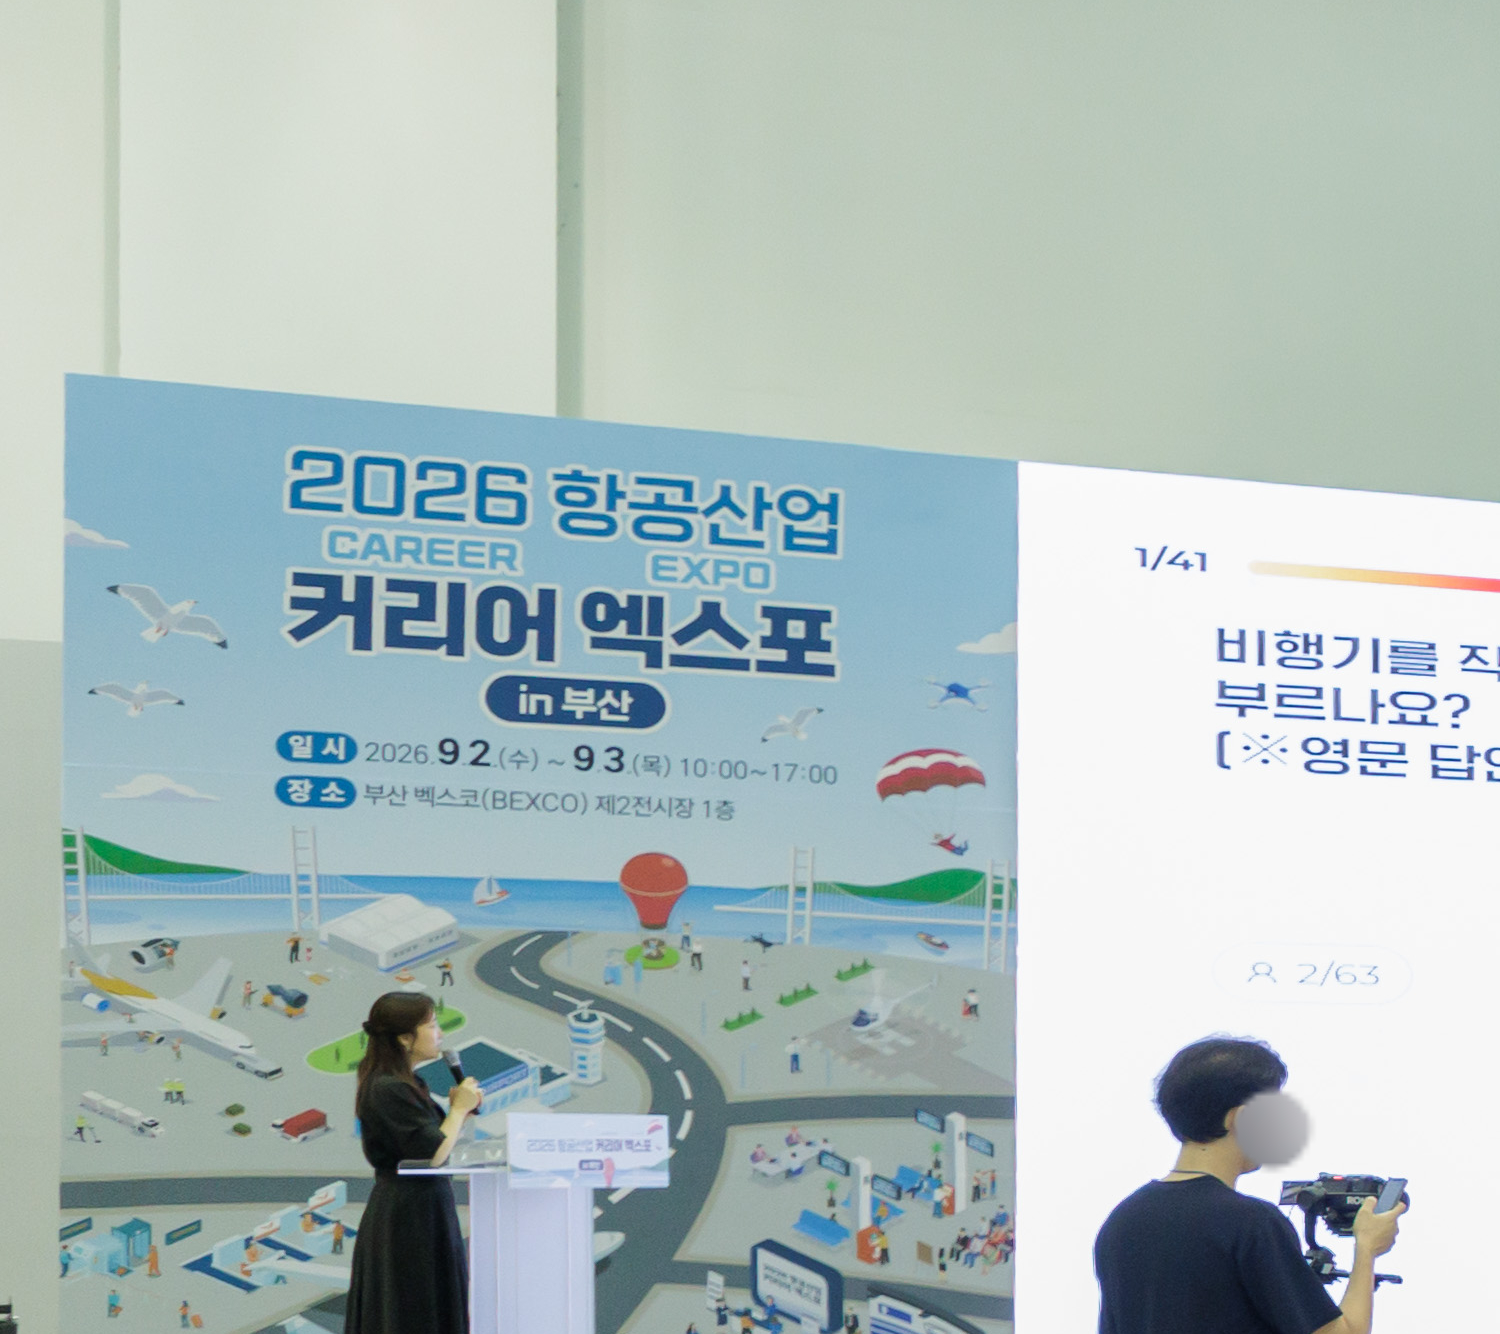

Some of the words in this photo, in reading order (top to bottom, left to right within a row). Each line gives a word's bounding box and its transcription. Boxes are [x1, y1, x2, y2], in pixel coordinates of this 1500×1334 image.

[289, 449, 528, 527] 2026
[551, 468, 840, 555] 항공산업
[327, 530, 519, 572] CAREER
[651, 554, 771, 589] EXPO
[1134, 545, 1208, 572] 1/41
[287, 571, 557, 663] 커리어
[580, 590, 837, 678] 엑스포
[1215, 627, 1439, 677] 비행기를
[518, 683, 554, 717] in
[560, 686, 635, 723] 부산
[1214, 679, 1472, 729] 부르나요?
[363, 784, 408, 807] 부산
[595, 794, 695, 820] 제2전시장
[702, 799, 736, 822] 1층
[1296, 960, 1380, 990] 2/63
